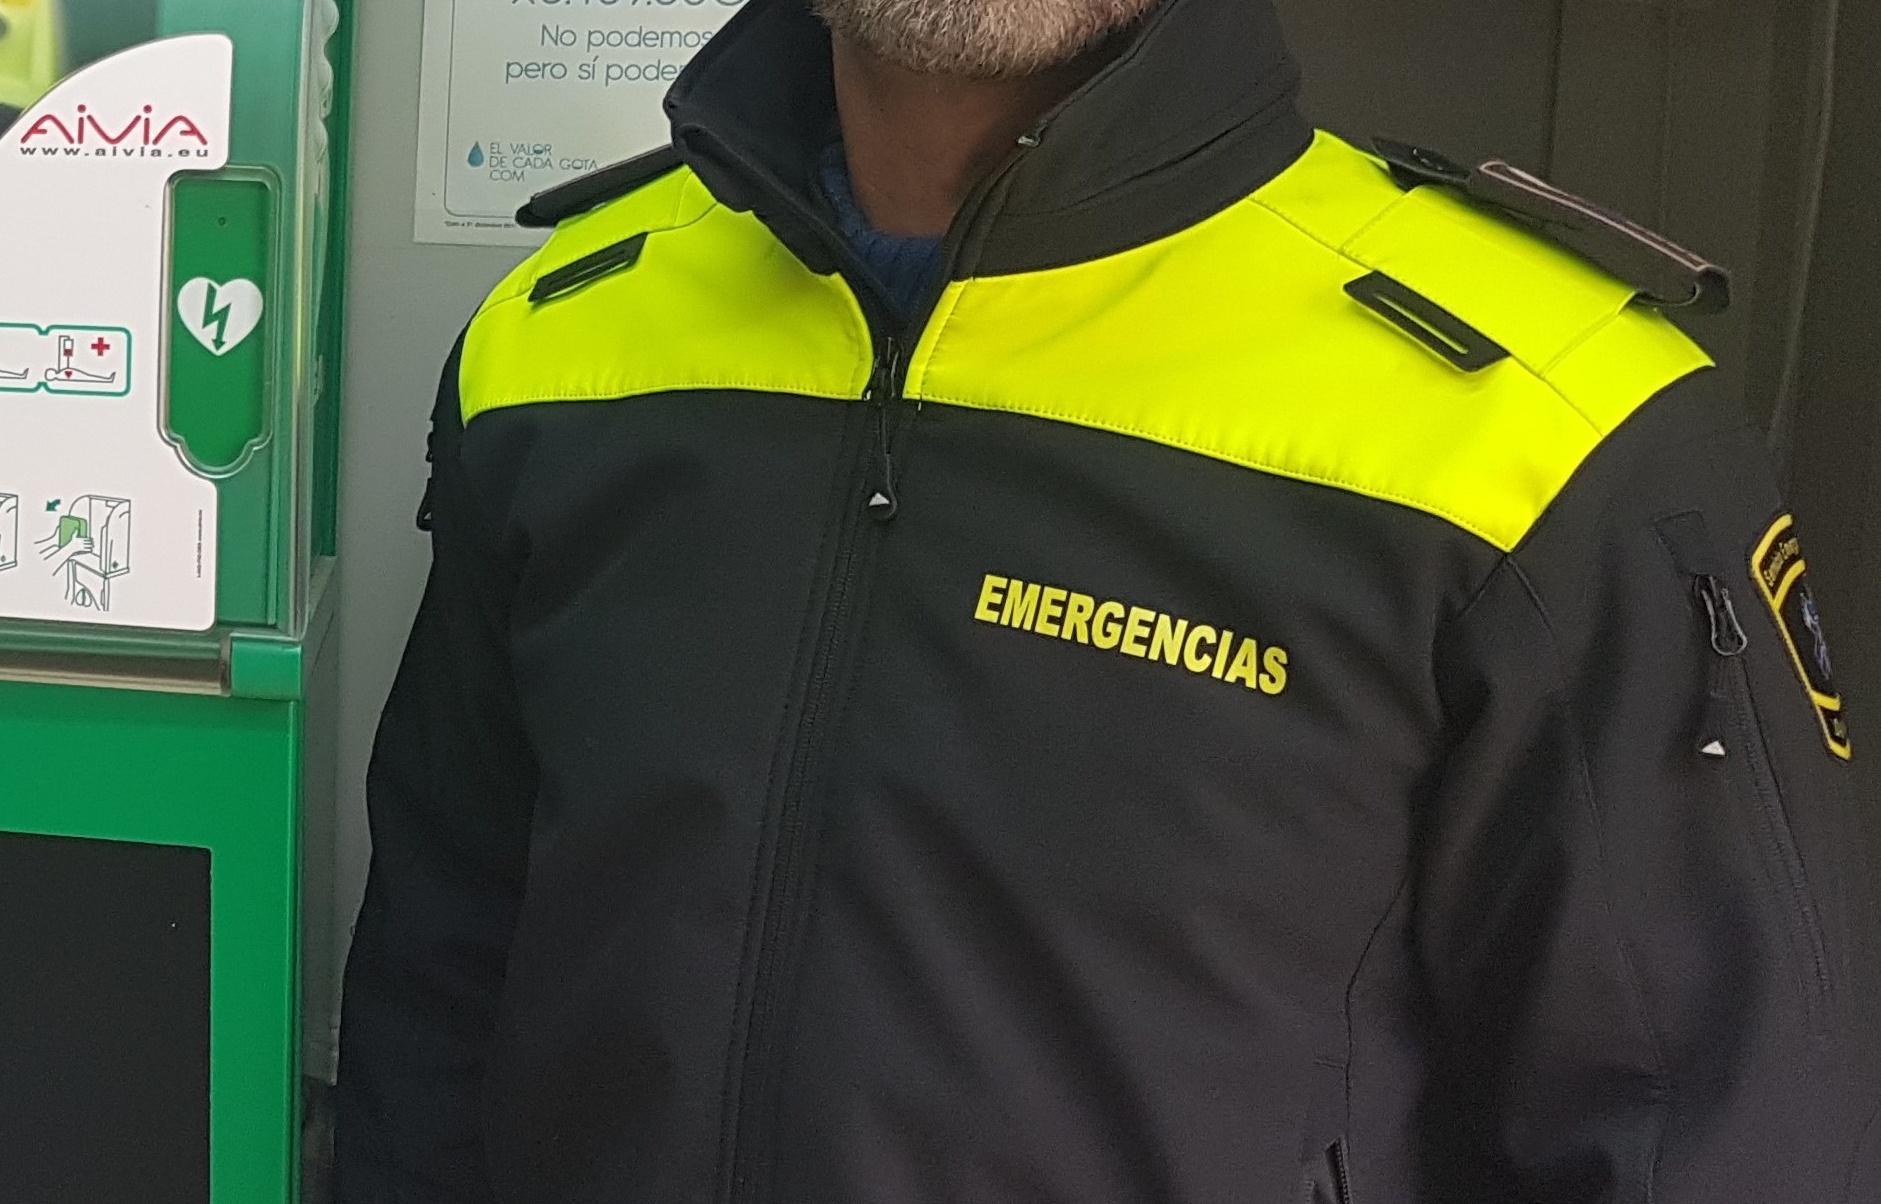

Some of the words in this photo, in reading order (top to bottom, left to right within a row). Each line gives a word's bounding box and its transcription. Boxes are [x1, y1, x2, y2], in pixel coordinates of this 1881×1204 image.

[540, 24, 577, 46] No
[505, 61, 567, 84] pero
[578, 55, 599, 81] sí
[605, 59, 684, 87] pode
[20, 146, 209, 158] www.aivia.eu
[489, 142, 502, 155] EL
[510, 143, 553, 156] VALOR
[489, 156, 508, 168] DE
[512, 157, 554, 170] CADA
[559, 159, 599, 171] GOTA
[489, 170, 525, 182] COM
[973, 574, 1288, 695] EMERGENCIAS
